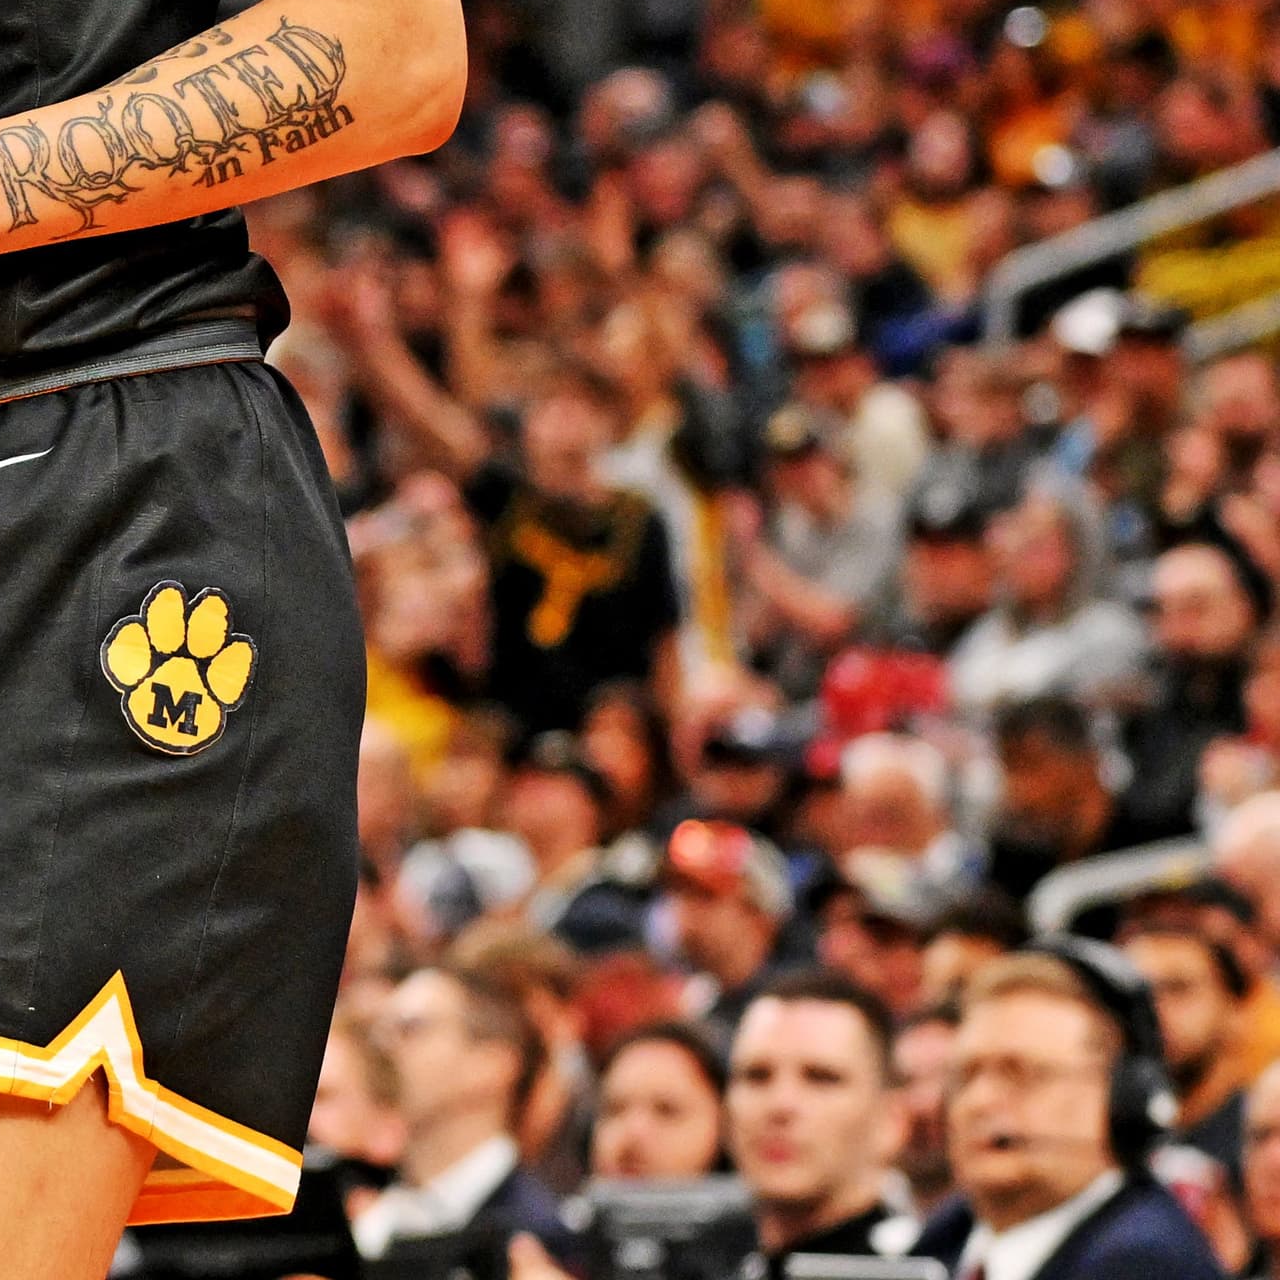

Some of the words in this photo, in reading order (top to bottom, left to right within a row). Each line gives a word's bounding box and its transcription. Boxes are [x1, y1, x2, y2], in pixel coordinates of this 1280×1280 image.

[192, 151, 244, 189] in
[258, 103, 355, 166] Faith
[146, 681, 204, 737] M
